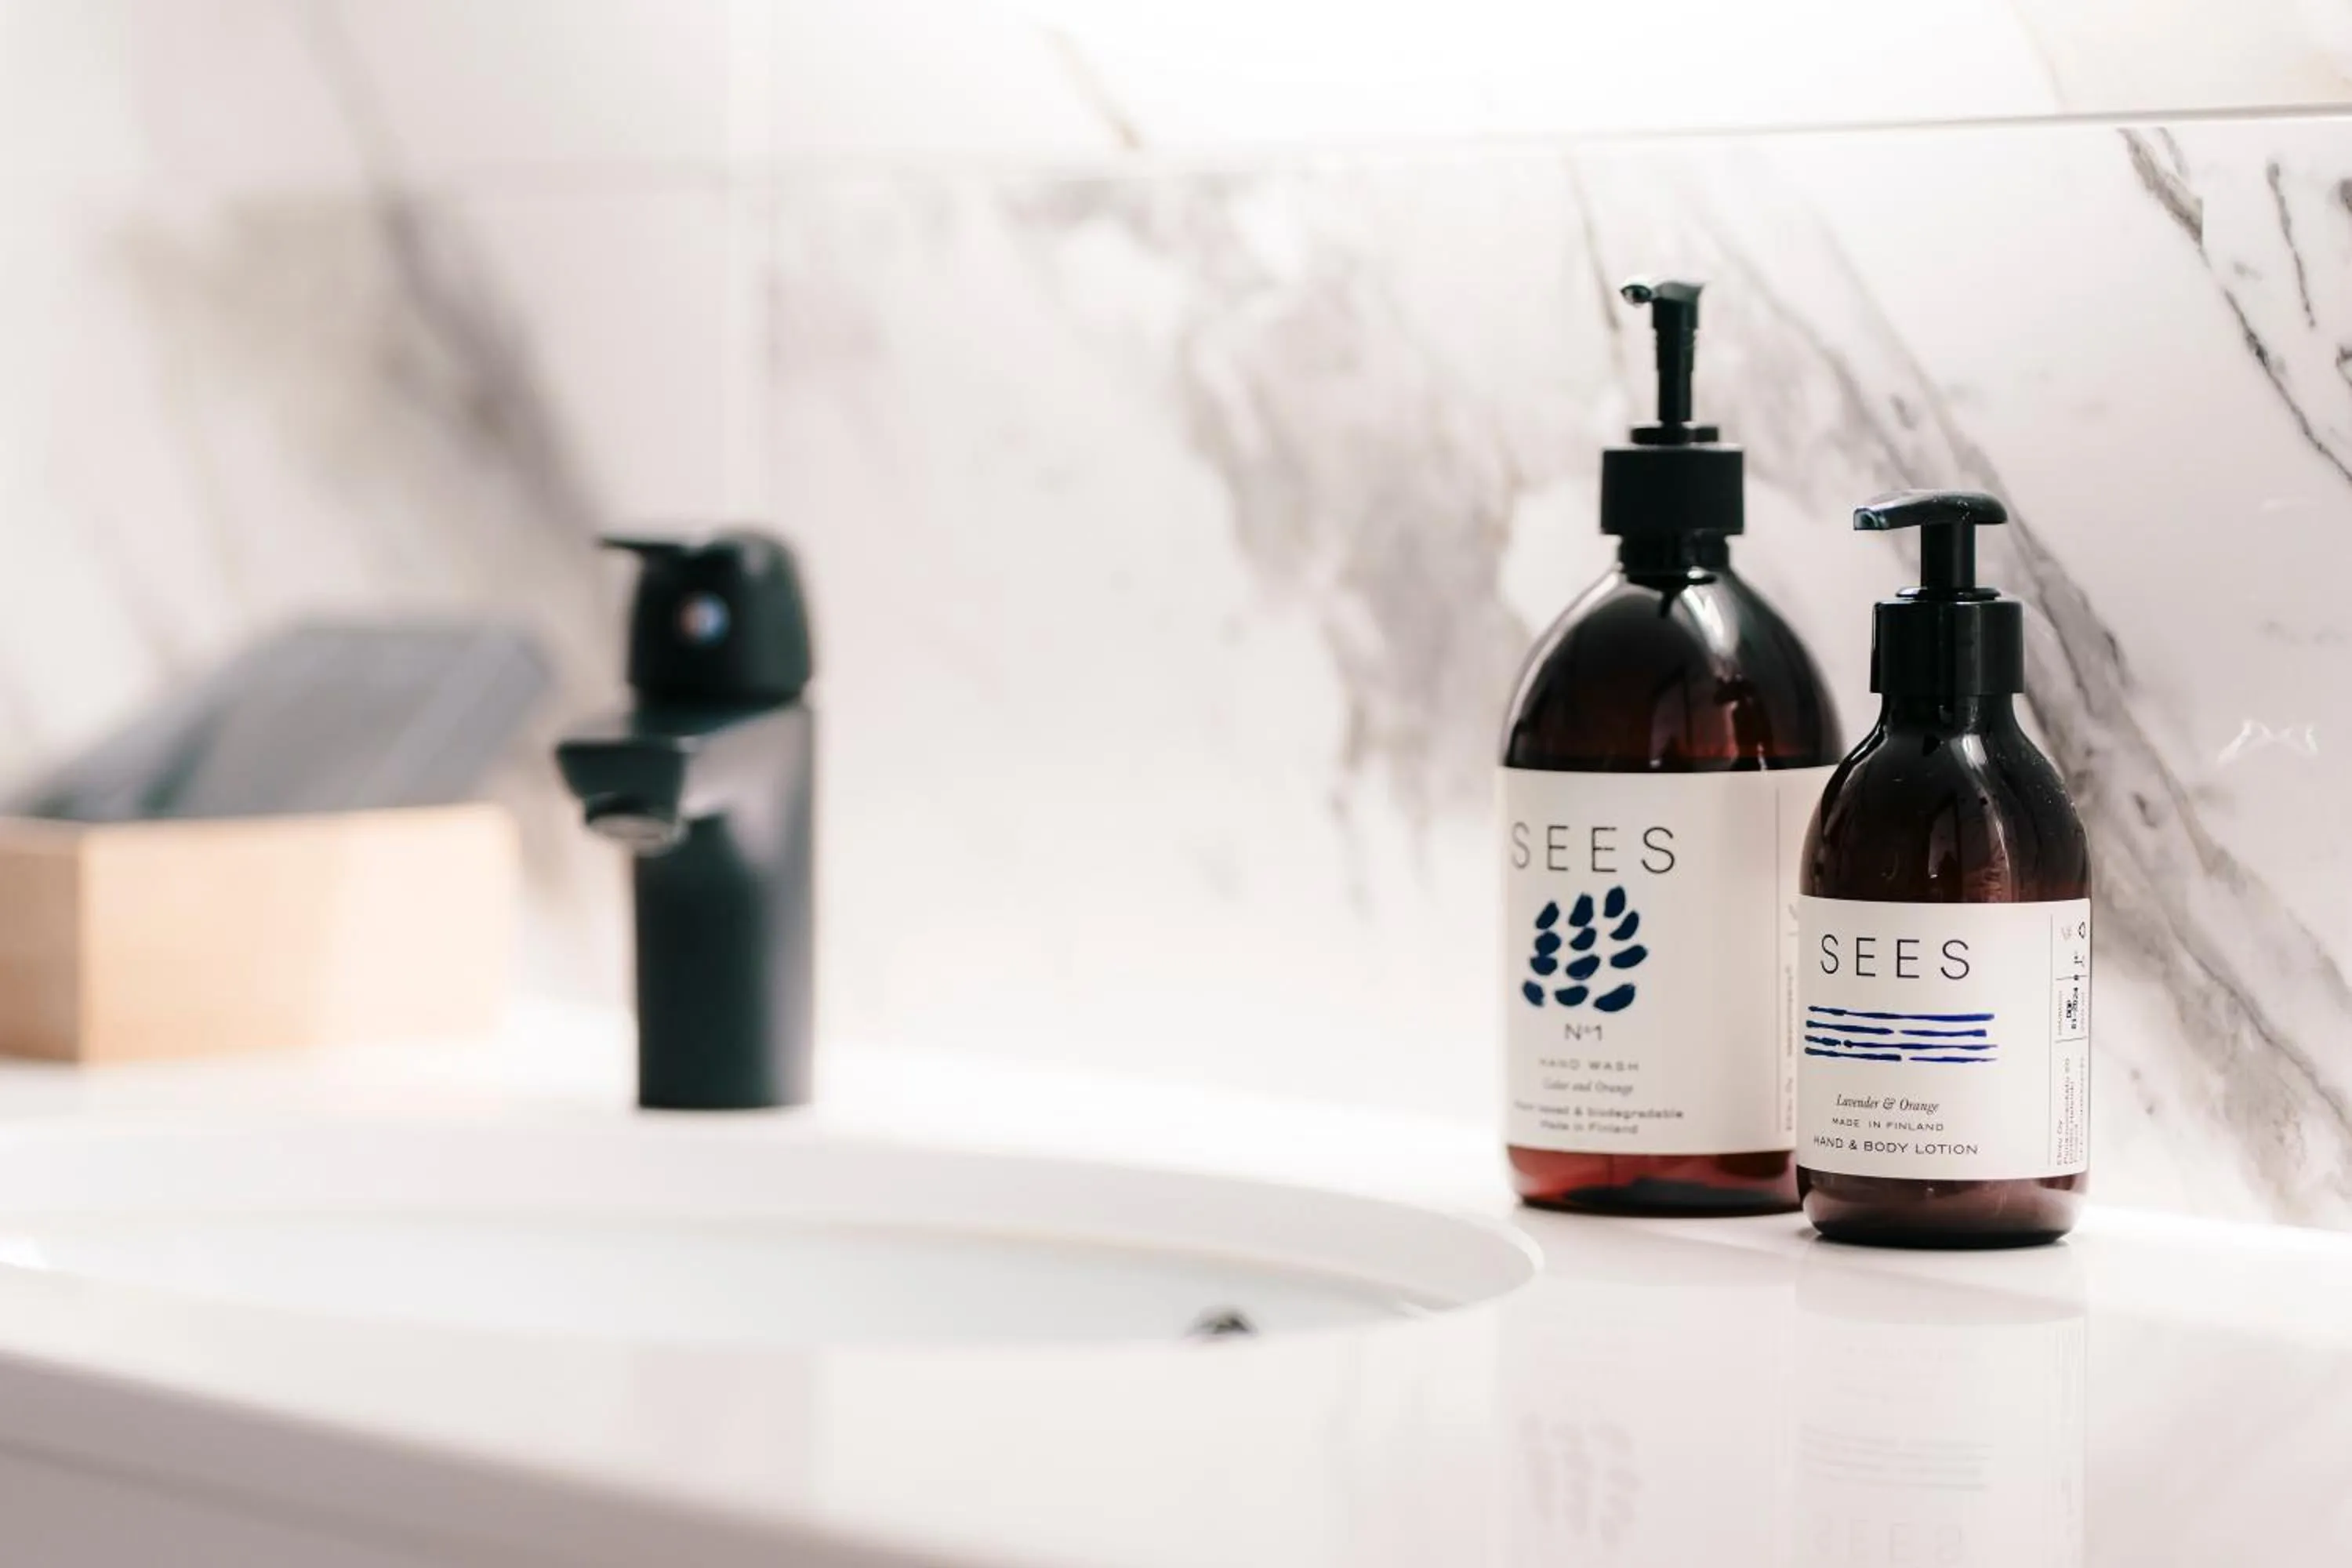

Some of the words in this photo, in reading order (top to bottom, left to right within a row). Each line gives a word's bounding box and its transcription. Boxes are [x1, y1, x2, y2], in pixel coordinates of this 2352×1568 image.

[1511, 822, 1675, 873] SEES
[1820, 934, 1970, 980] SEES
[1539, 1058, 1581, 1070] HAND
[1588, 1060, 1639, 1072] WASH
[1572, 1080, 1592, 1091] and
[1595, 1080, 1634, 1097] Orange
[1587, 1106, 1684, 1120] biodegradable
[1835, 1094, 1879, 1111] Lavender
[1882, 1097, 1896, 1111] &
[1899, 1097, 1940, 1116] Orange
[1588, 1122, 1639, 1134] Finland
[1831, 1117, 1860, 1128] MADE
[1868, 1120, 1881, 1129] IN
[1886, 1121, 1944, 1131] FINLAND
[1813, 1134, 1843, 1149] HAND
[1849, 1139, 1858, 1150] &
[1863, 1141, 1909, 1154] BODY
[1915, 1143, 1978, 1155] LOTION
